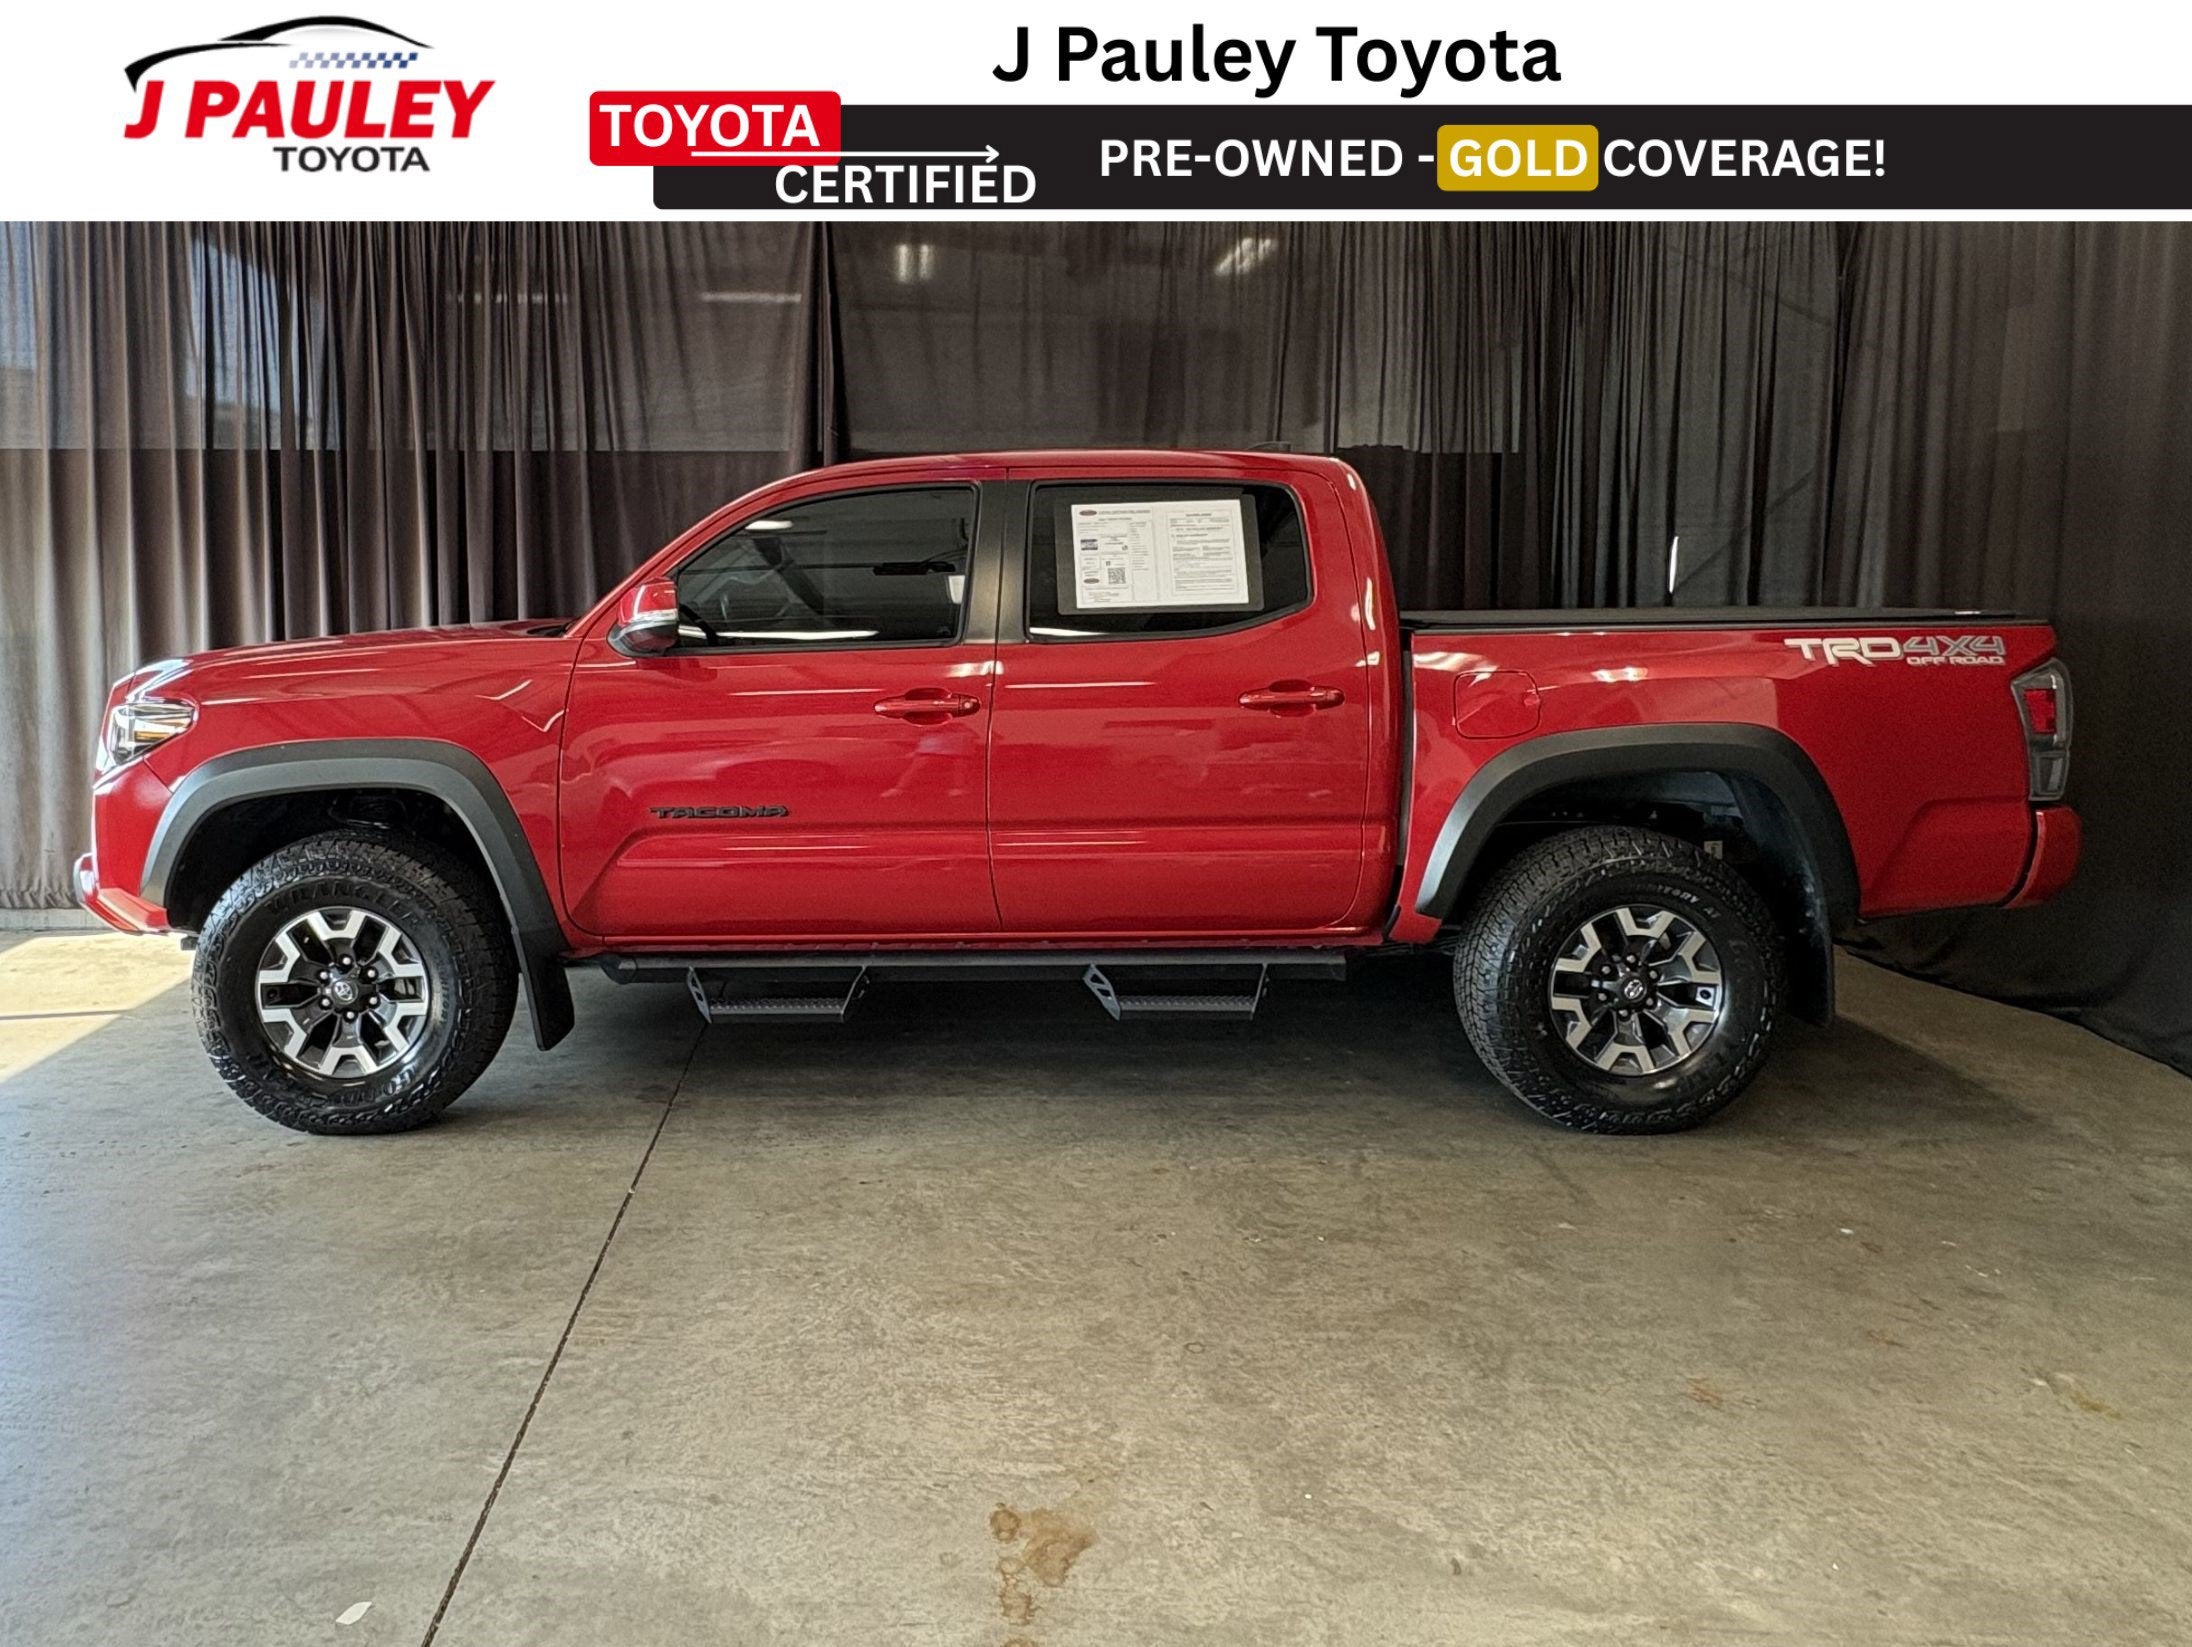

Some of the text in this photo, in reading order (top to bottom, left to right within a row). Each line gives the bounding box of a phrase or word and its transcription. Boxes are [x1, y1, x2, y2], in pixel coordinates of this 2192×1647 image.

[1784, 637, 1903, 667] TRD
[1906, 656, 2006, 666] OFF ROAD
[650, 805, 789, 818] TACOMA
